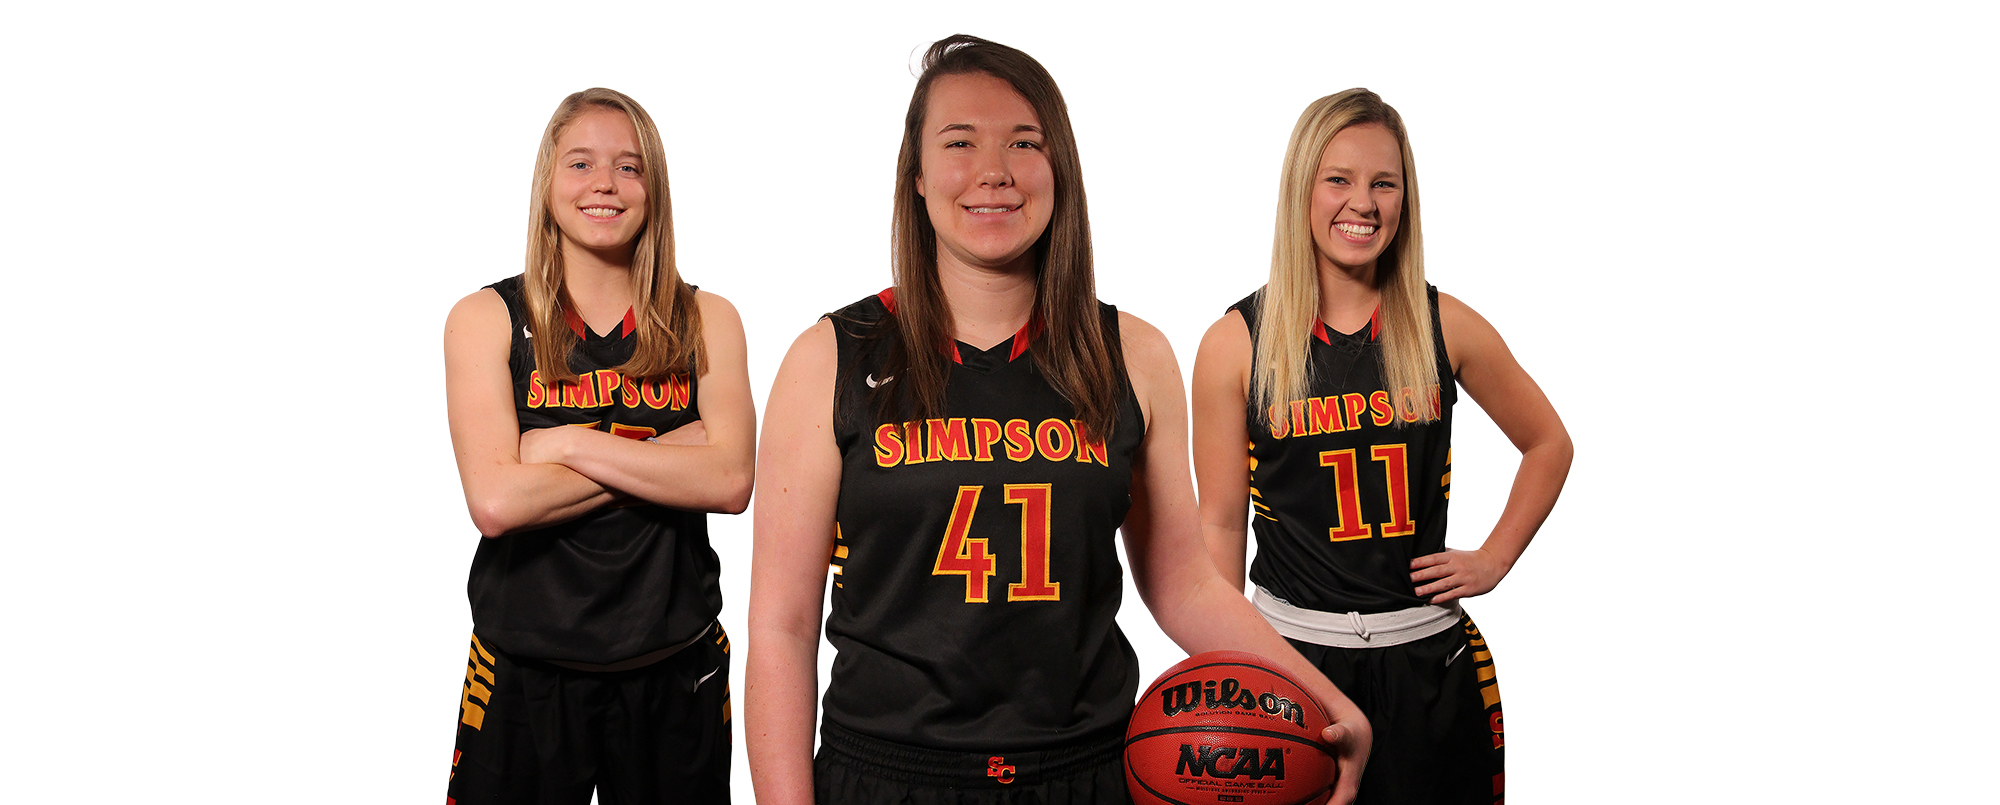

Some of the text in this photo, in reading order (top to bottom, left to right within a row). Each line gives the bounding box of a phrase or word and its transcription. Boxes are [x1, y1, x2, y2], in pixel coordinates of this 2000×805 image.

[527, 369, 691, 411] SIMPSON
[873, 417, 1109, 468] SIMPSON
[1318, 443, 1416, 542] 11
[931, 483, 1060, 603] 41
[1161, 678, 1305, 729] Wilson
[1175, 744, 1285, 780] NCAA
[1178, 778, 1223, 787] OFFICIAL
[1225, 781, 1256, 789] GAME
